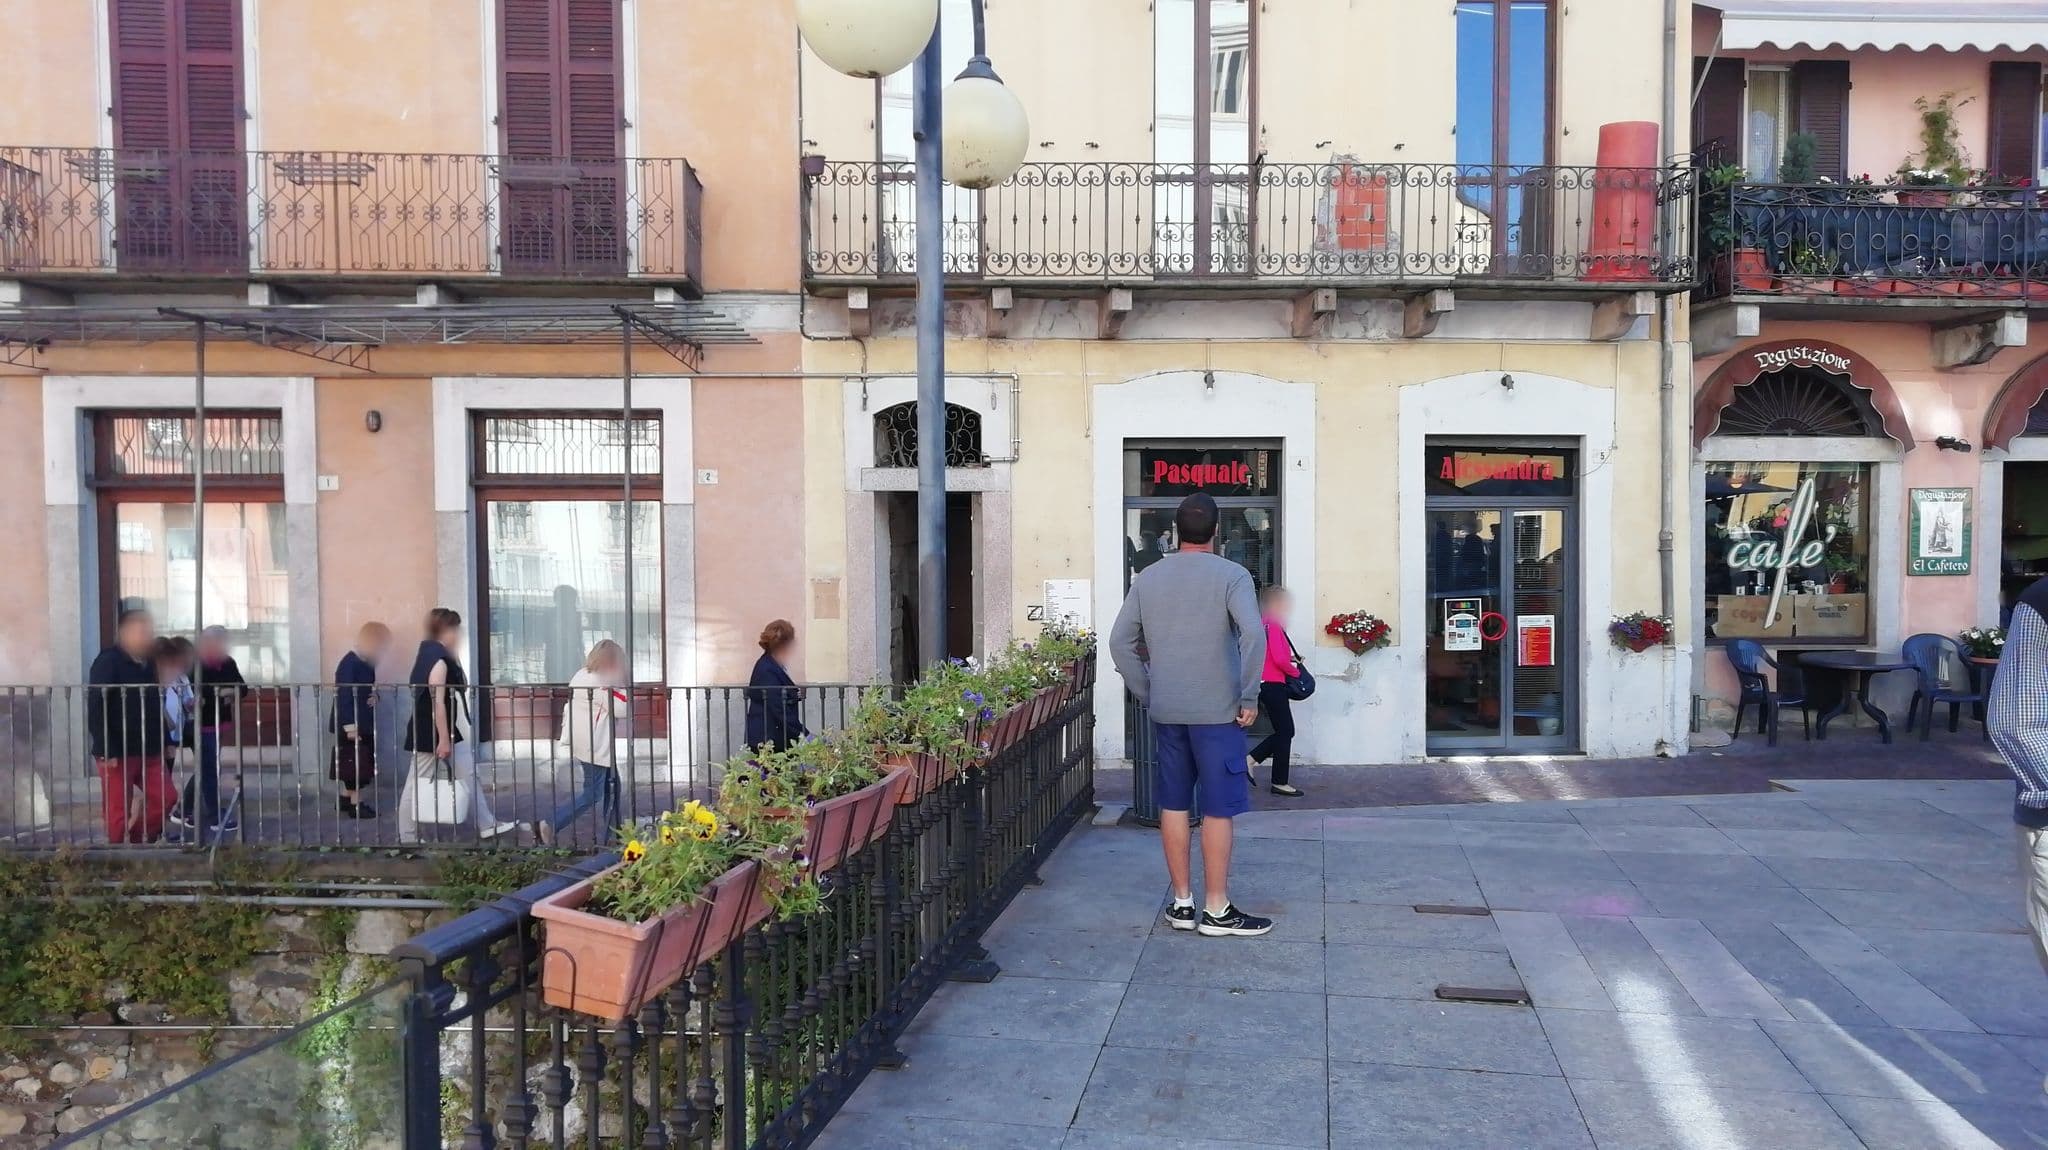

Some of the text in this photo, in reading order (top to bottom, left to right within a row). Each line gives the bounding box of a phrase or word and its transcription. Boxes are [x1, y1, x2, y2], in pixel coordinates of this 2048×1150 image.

[1600, 451, 1605, 460] 5
[1153, 460, 1250, 487] Pasquale
[1913, 559, 1968, 573] El Cafetero
